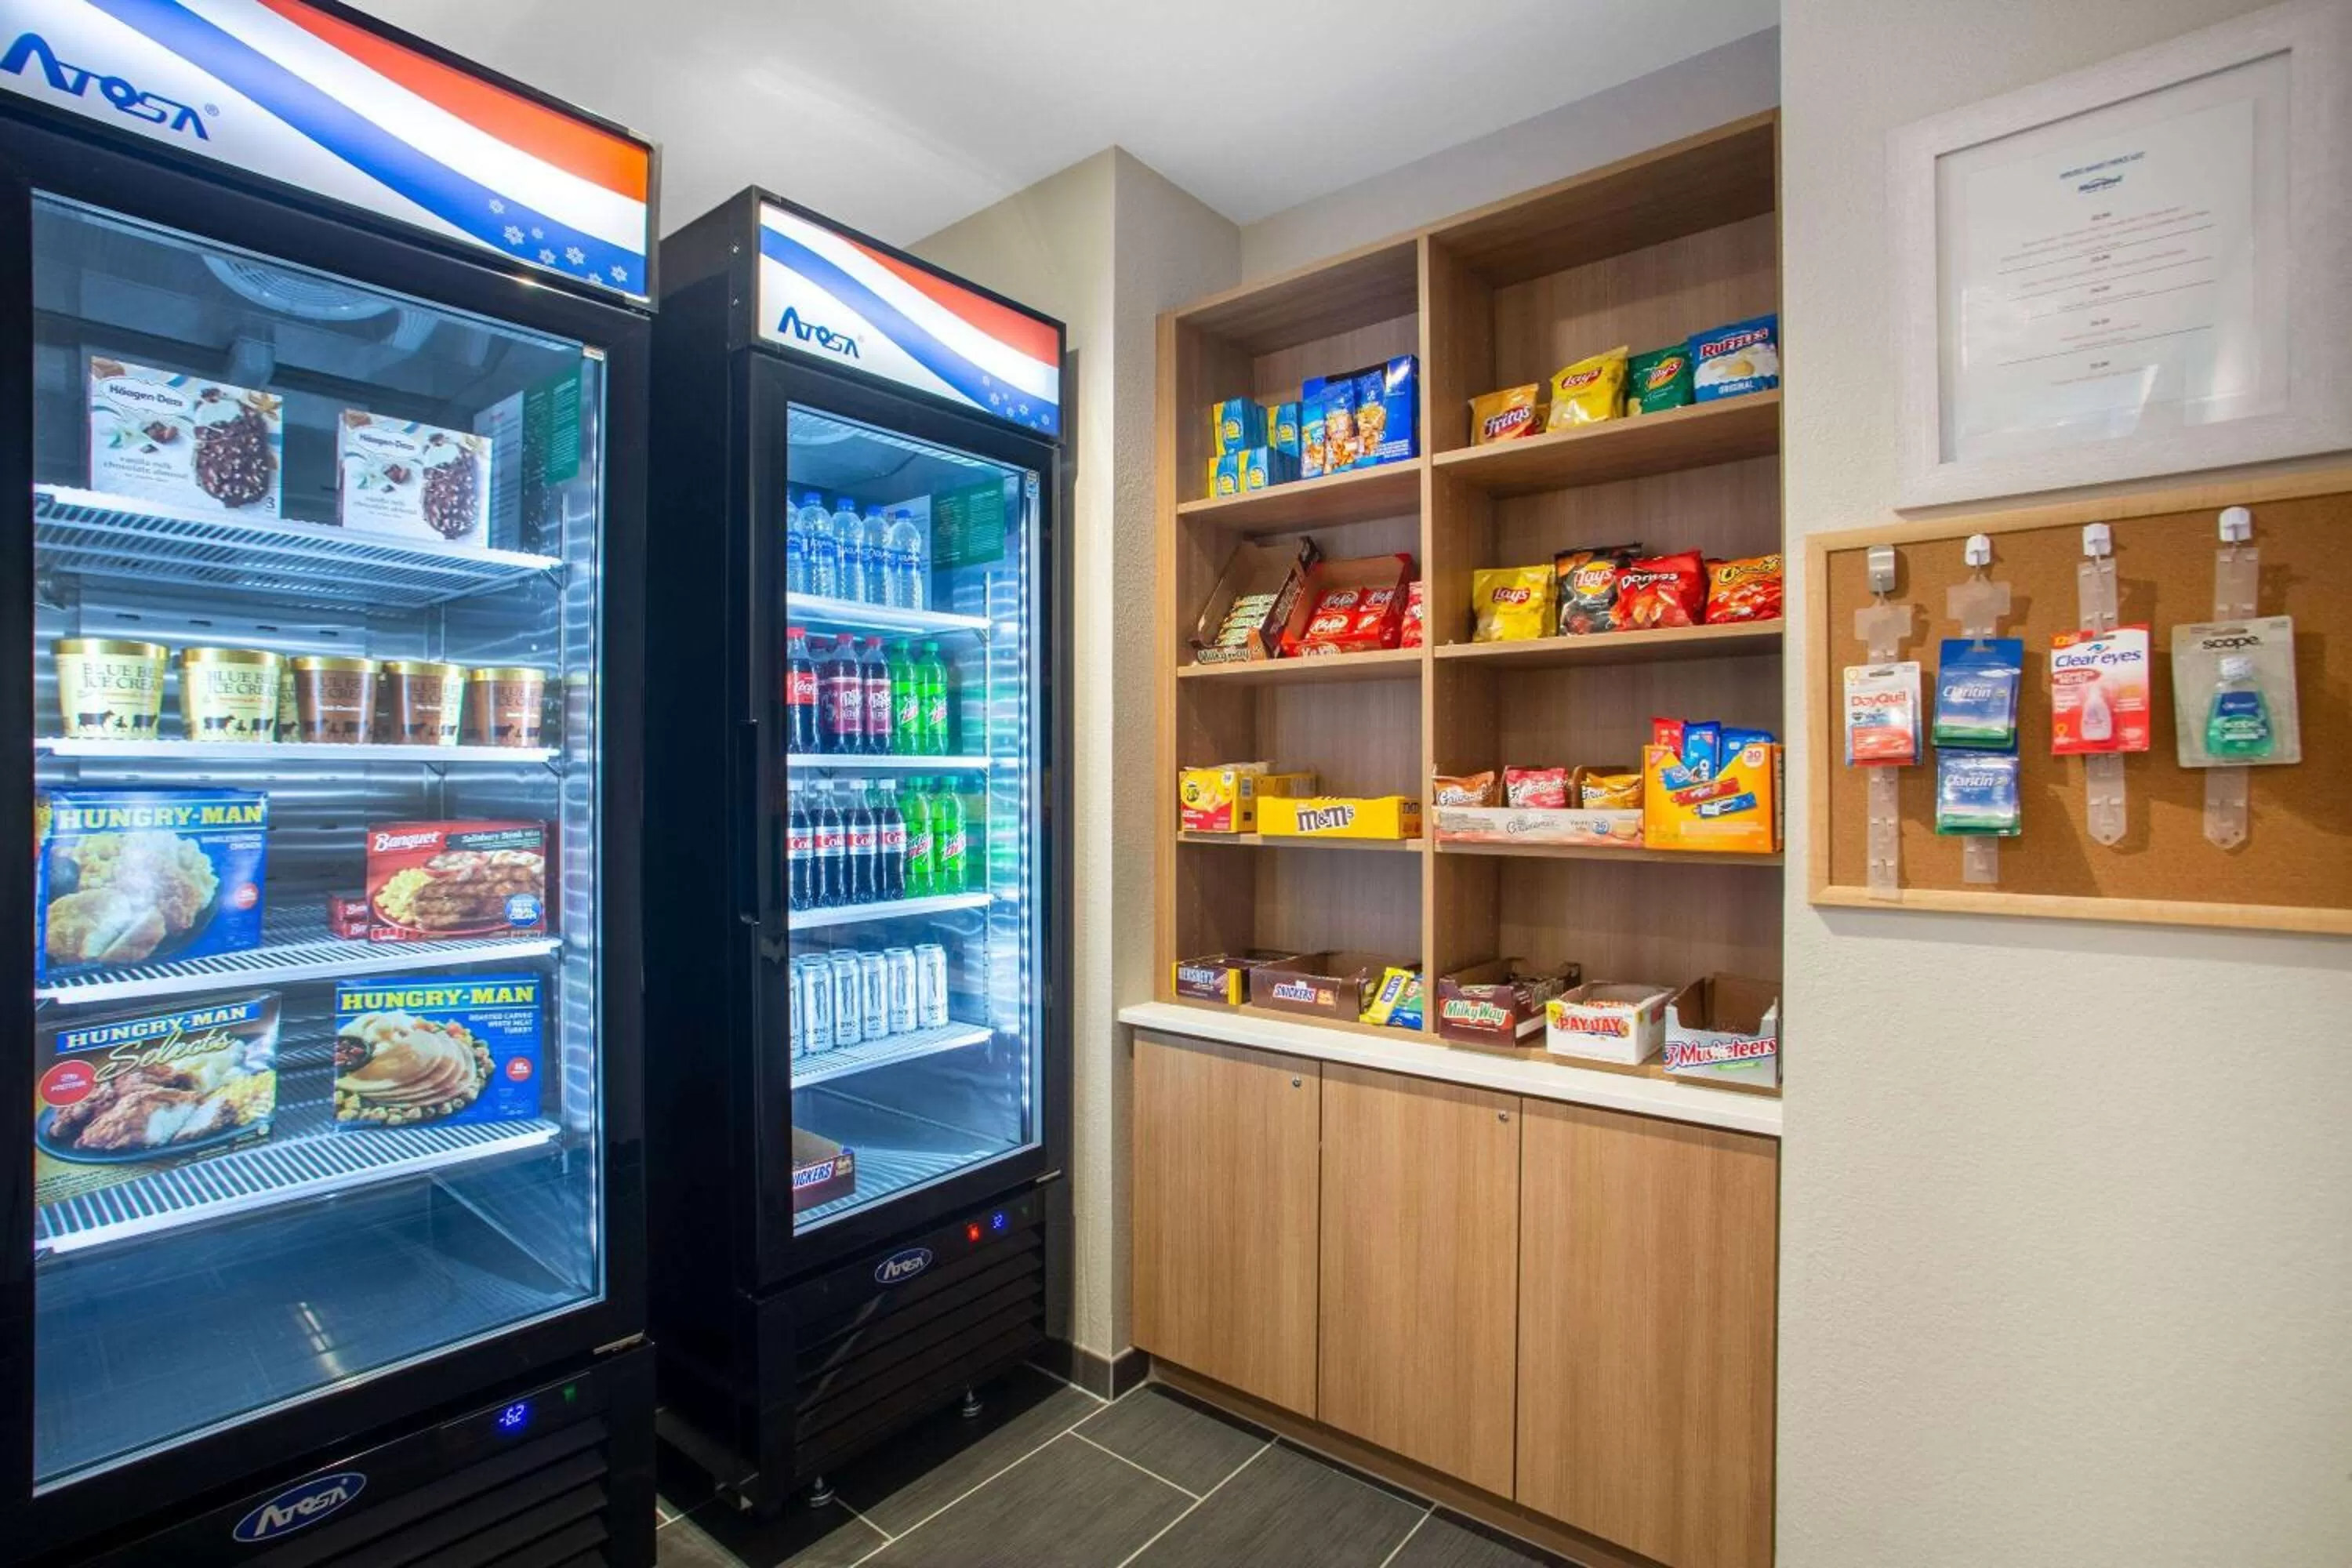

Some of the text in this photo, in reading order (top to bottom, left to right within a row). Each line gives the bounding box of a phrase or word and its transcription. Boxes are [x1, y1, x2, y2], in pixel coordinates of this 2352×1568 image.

[1485, 405, 1531, 437] Fritos
[1621, 572, 1678, 590] Doritos
[2203, 635, 2259, 650] scope
[2055, 650, 2141, 668] Clear eyes
[57, 805, 263, 829] HUNGRY-MAN
[372, 831, 442, 851] Banquet
[341, 985, 535, 1011] HUNGRY-MAN
[66, 1006, 248, 1048] HUNGRY-MAN
[93, 1027, 236, 1083] Selects
